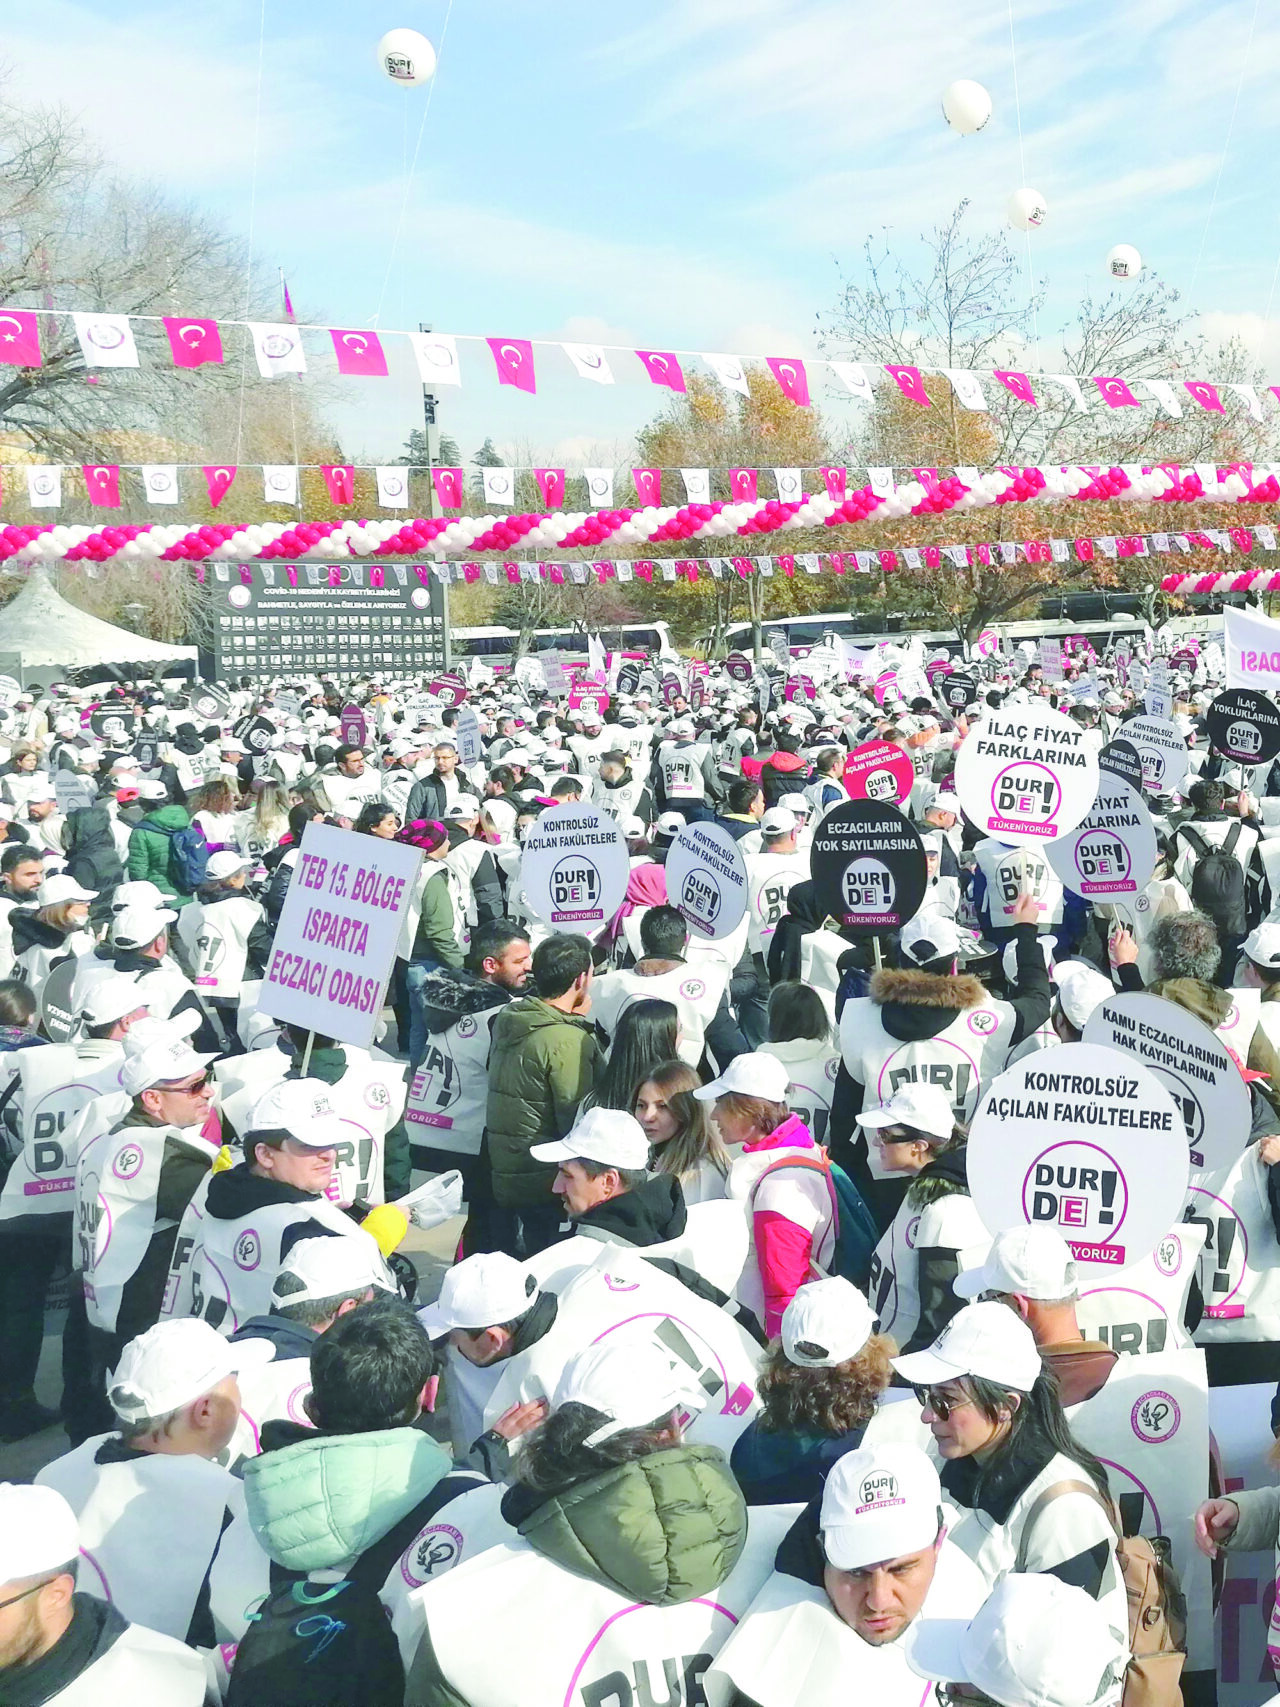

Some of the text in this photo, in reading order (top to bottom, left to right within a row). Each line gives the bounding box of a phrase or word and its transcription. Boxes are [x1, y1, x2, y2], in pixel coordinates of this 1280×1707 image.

[263, 587, 297, 595] COVİD-19
[299, 601, 333, 609] SAYGIYLA
[1237, 695, 1257, 711] İLAÇ
[1213, 702, 1279, 726] YOKLUKLARINA
[988, 718, 1083, 747] İLAÇ FİYAT
[1119, 728, 1184, 751] AÇILAN FAKÜLTELERE
[1133, 722, 1174, 739] KONTROLSÜZ
[1230, 727, 1253, 739] DUR
[853, 745, 891, 761] KONTROLSÜZ
[976, 740, 1087, 768] FARKLARINA
[665, 763, 685, 773] DUR
[845, 751, 904, 774] AÇILAN FAKÜLTELERE
[867, 776, 888, 788] DUR
[1001, 776, 1042, 795] DUR
[543, 816, 599, 833] KONTROLSÜZ
[827, 821, 902, 835] ECZACILARIN
[993, 821, 1052, 835] TÜKENİYORUZ
[527, 830, 617, 852] AÇILAN FAKÜLTELERE
[692, 828, 736, 865] KONTROLSÜZ
[815, 835, 918, 852] YOK SAYILMASINA
[1080, 844, 1113, 857] DUR
[677, 834, 744, 888] AÇILAN FAKÜLTELERE
[298, 852, 406, 911] TEB 15. BÖLGE
[555, 870, 587, 885] DUR
[847, 871, 880, 887] DUR
[688, 875, 712, 901] DUR
[1085, 881, 1134, 893] TÜKENİYORUZ
[553, 909, 602, 922] TÜKENİYORUZ
[679, 906, 714, 935] TÜKENİYORUZ
[847, 913, 898, 925] TÜKENİYORUZ
[302, 907, 369, 957] ISPARTA
[269, 950, 381, 1014] ECZACI ODASI
[1101, 1006, 1228, 1072] KAMU ECZACILARININ
[1111, 1030, 1217, 1086] HAK KAYIPLARINA
[1024, 1070, 1139, 1099] KONTROLSÜZ
[986, 1096, 1173, 1131] AÇILAN FAKÜLTELERE
[1035, 1163, 1100, 1191] DUR
[864, 1478, 888, 1492] DUR
